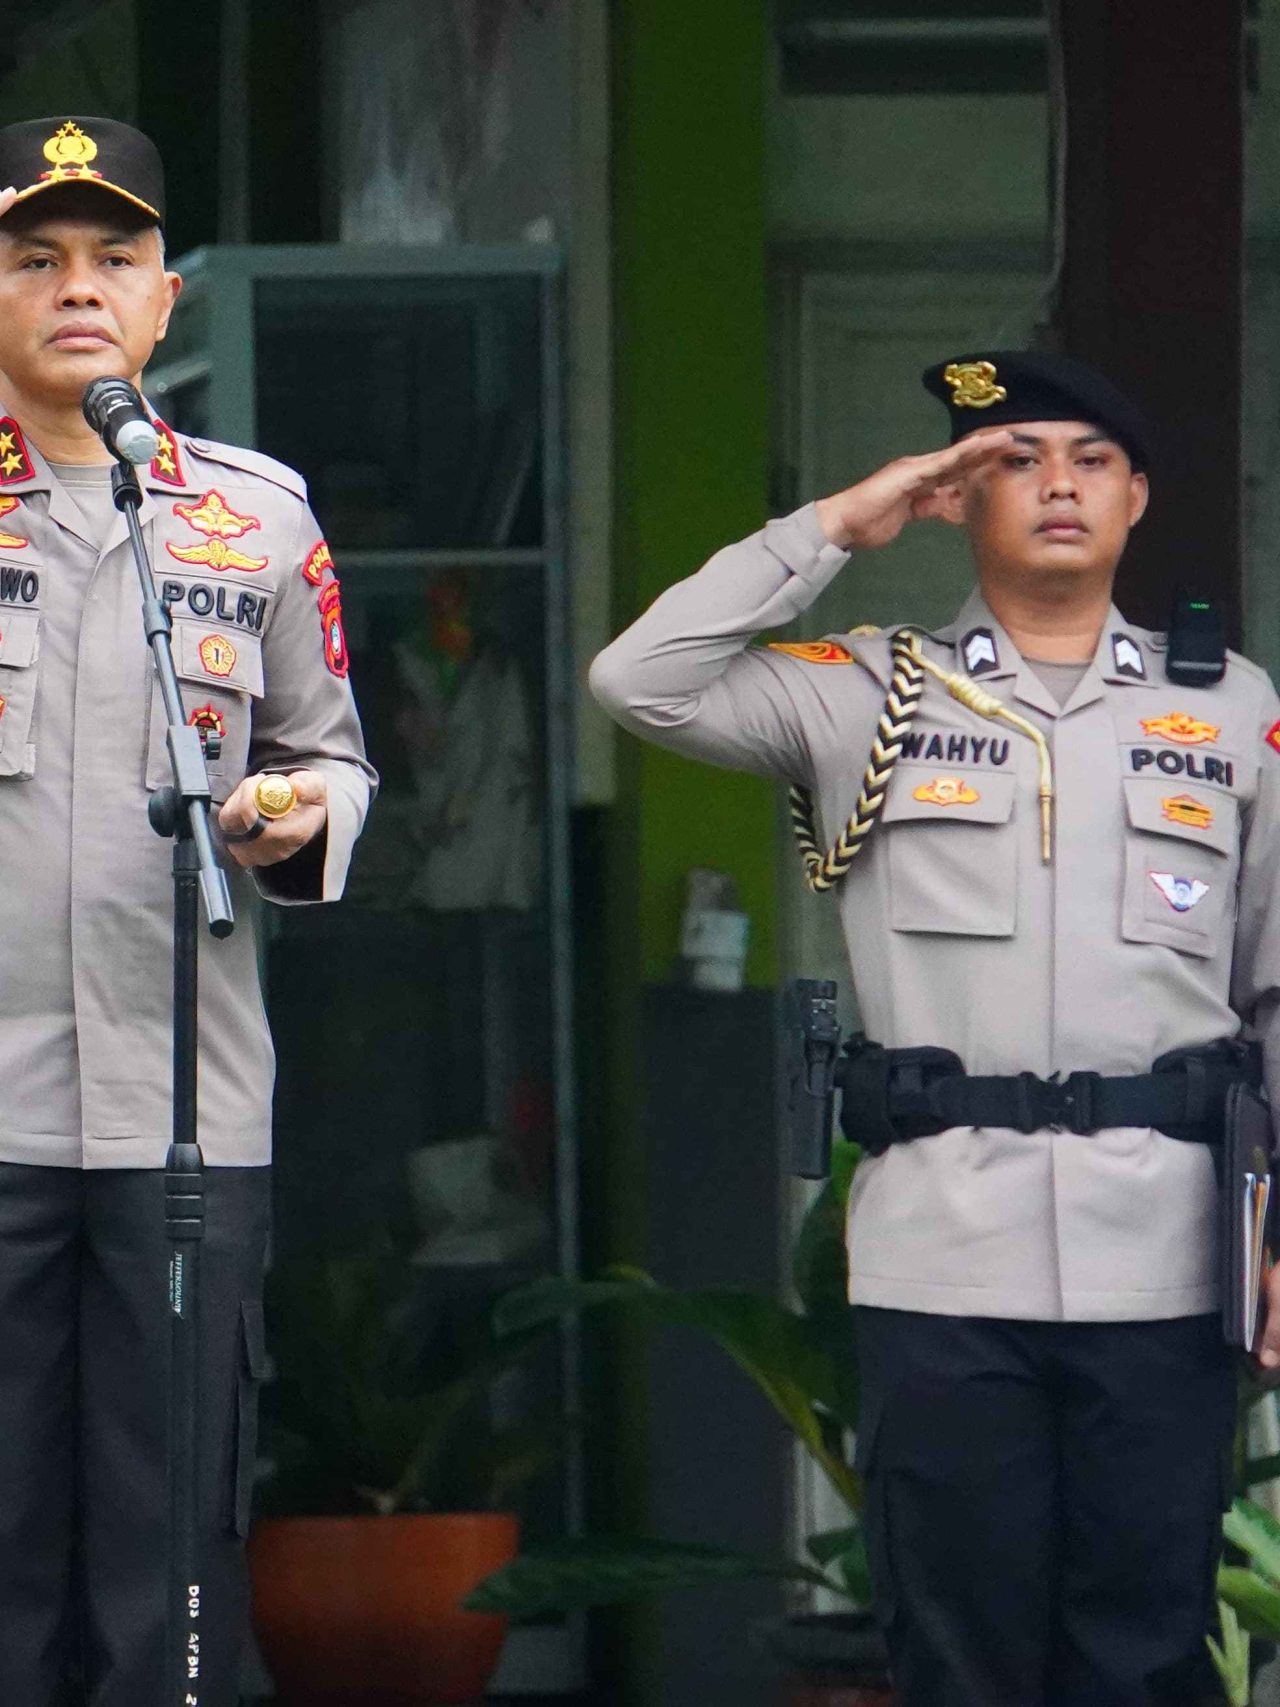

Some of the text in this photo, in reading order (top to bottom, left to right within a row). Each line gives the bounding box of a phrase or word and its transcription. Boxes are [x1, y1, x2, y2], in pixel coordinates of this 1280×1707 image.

[162, 580, 267, 632] POLRI
[901, 732, 1010, 766] WAHYU
[1130, 748, 1234, 787] POLRI
